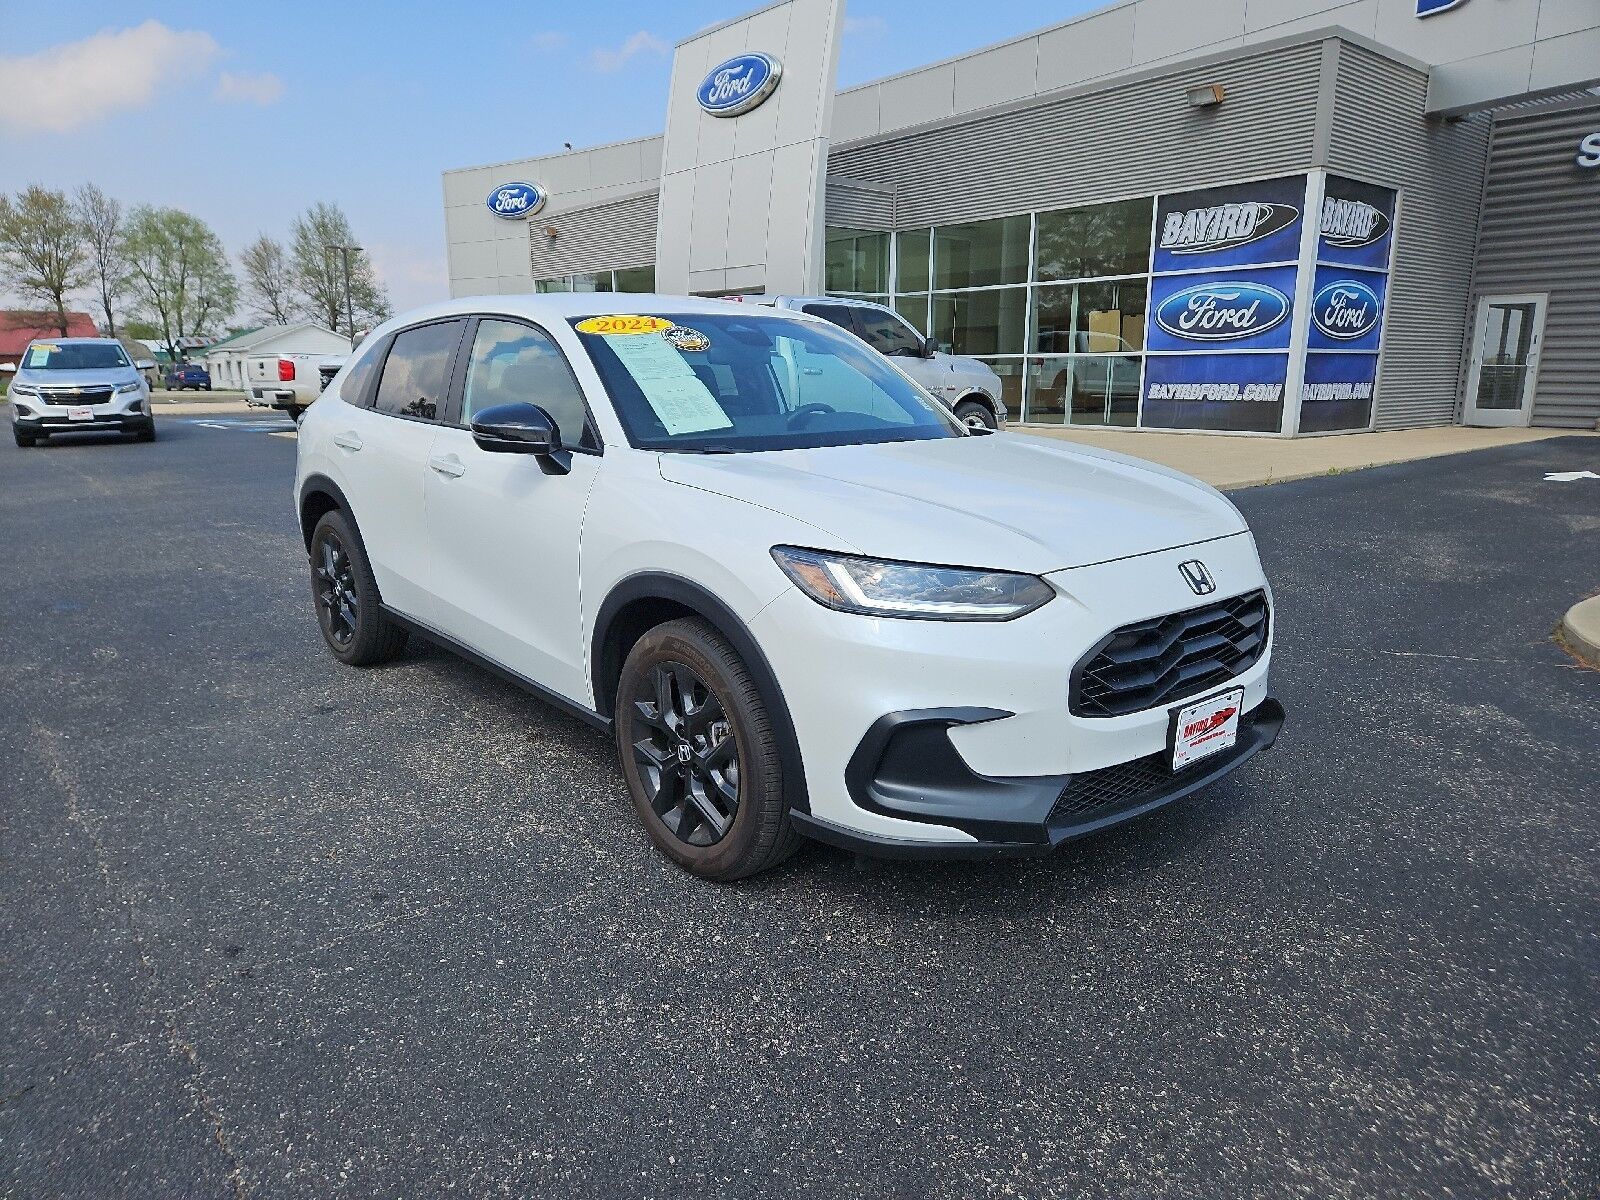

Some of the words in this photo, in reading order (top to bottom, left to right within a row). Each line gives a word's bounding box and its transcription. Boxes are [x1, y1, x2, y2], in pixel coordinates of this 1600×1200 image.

[708, 64, 753, 103] Ford
[495, 188, 528, 211] Ford
[1321, 196, 1374, 240] BAYIRD
[1160, 202, 1260, 247] BAYIRD
[595, 318, 657, 332] 2024
[1179, 292, 1260, 329] Ford
[1325, 289, 1366, 328] Ford
[1147, 382, 1282, 401] BAYIRDFORD.COM
[1302, 382, 1372, 400] BAYIRDFORD.COM
